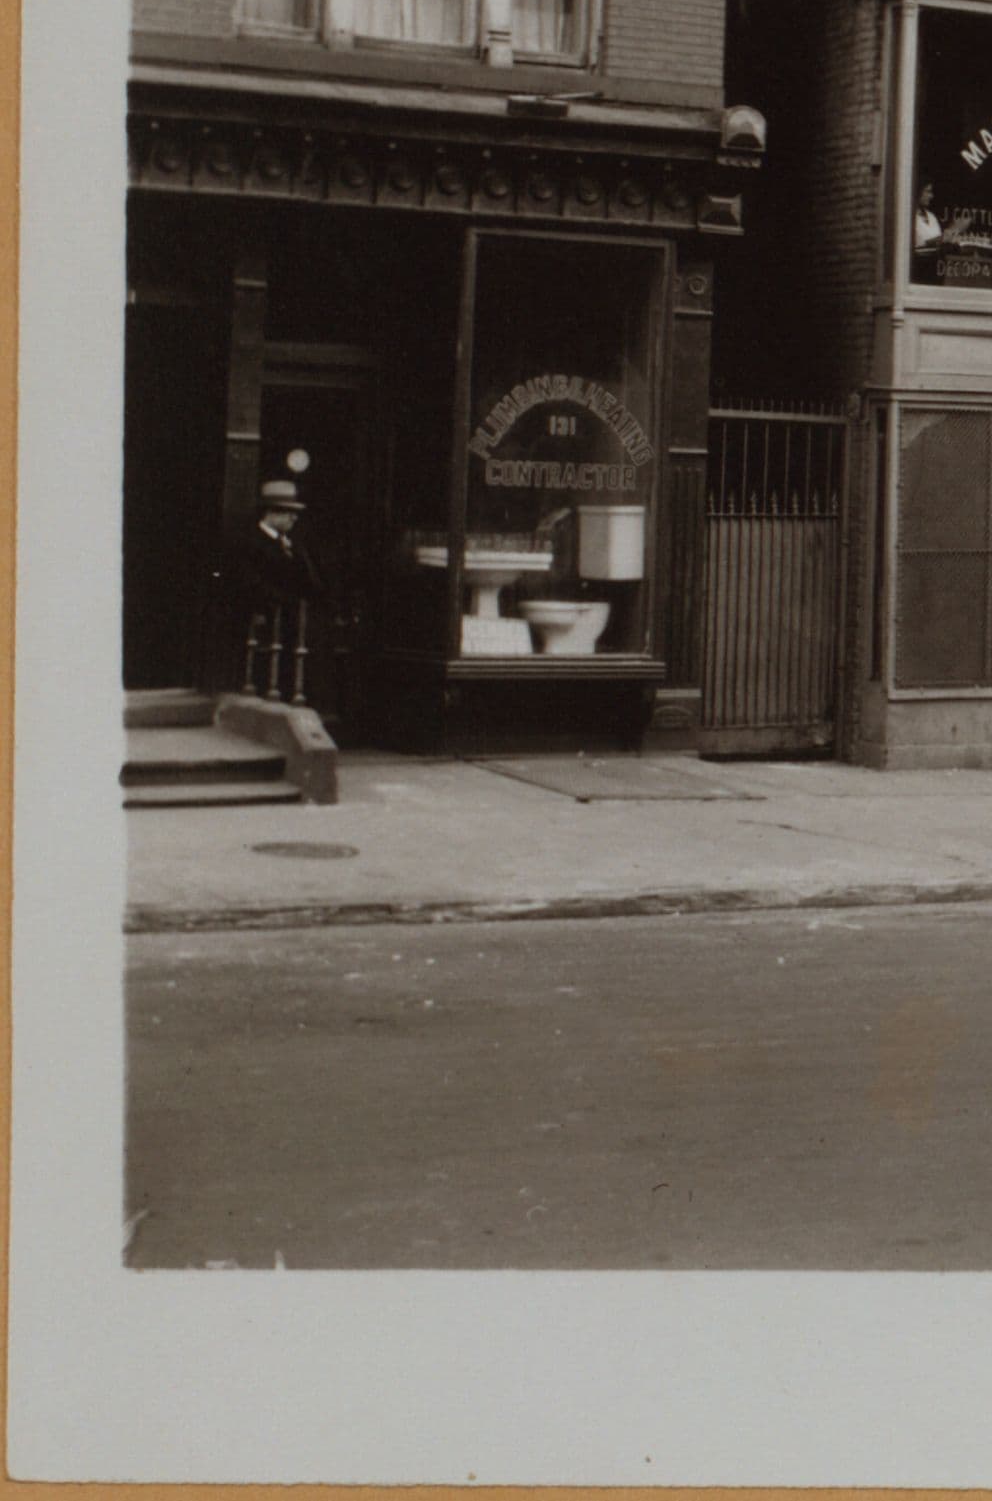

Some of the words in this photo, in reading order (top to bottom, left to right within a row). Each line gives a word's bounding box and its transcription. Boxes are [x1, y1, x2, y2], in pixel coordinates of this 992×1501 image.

[468, 373, 568, 460] PLUMBING
[584, 381, 657, 467] HEATING
[485, 458, 637, 491] CONTRACTOR
